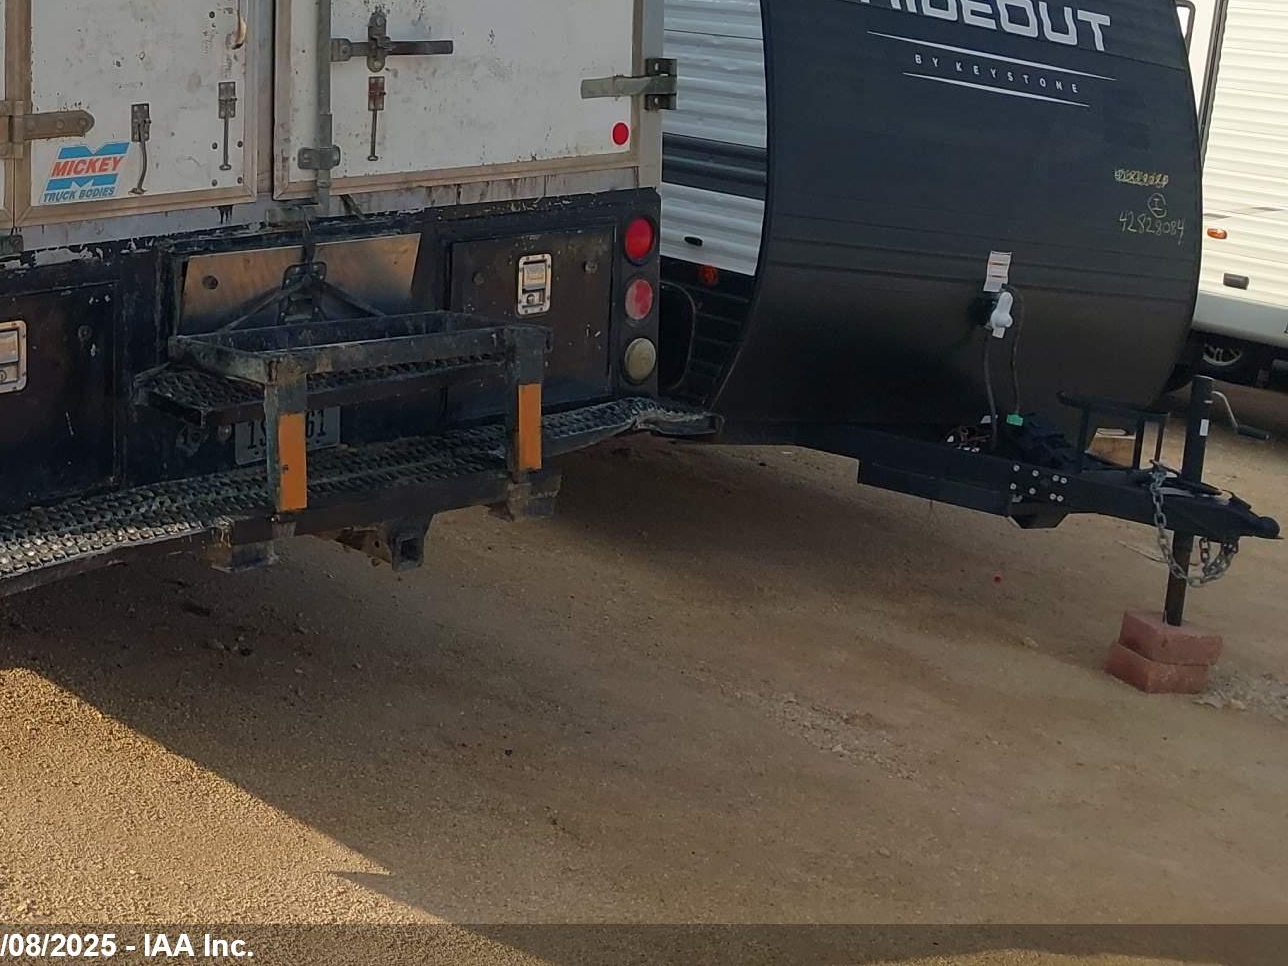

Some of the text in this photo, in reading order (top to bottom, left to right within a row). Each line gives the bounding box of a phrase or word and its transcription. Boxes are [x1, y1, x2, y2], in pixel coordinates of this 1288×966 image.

[914, 54, 1079, 94] BY KEYSTONE
[52, 157, 123, 176] MICKEY
[44, 187, 115, 202] TRUCK BODIES
